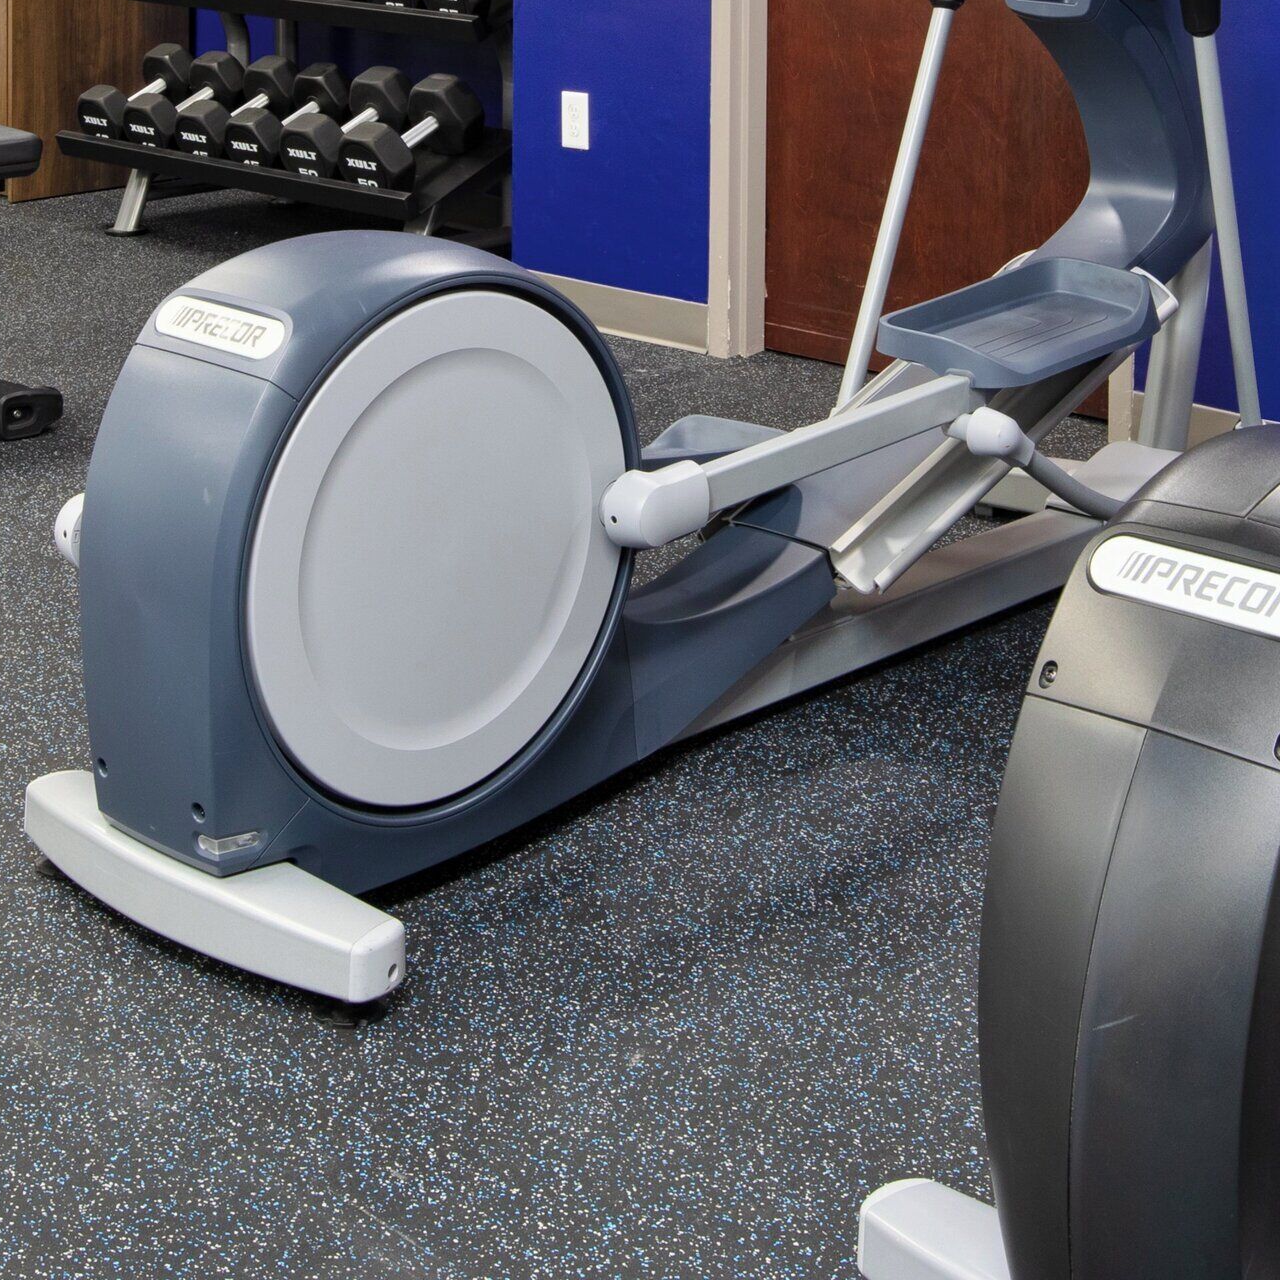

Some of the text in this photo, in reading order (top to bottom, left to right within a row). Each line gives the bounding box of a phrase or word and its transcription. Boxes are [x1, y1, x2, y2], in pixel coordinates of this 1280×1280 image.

[83, 115, 108, 127] XULT
[129, 123, 155, 136] XULT
[180, 131, 207, 144] XULT
[230, 140, 258, 153] XULT
[287, 147, 317, 161] XULT
[345, 157, 378, 171] XULT
